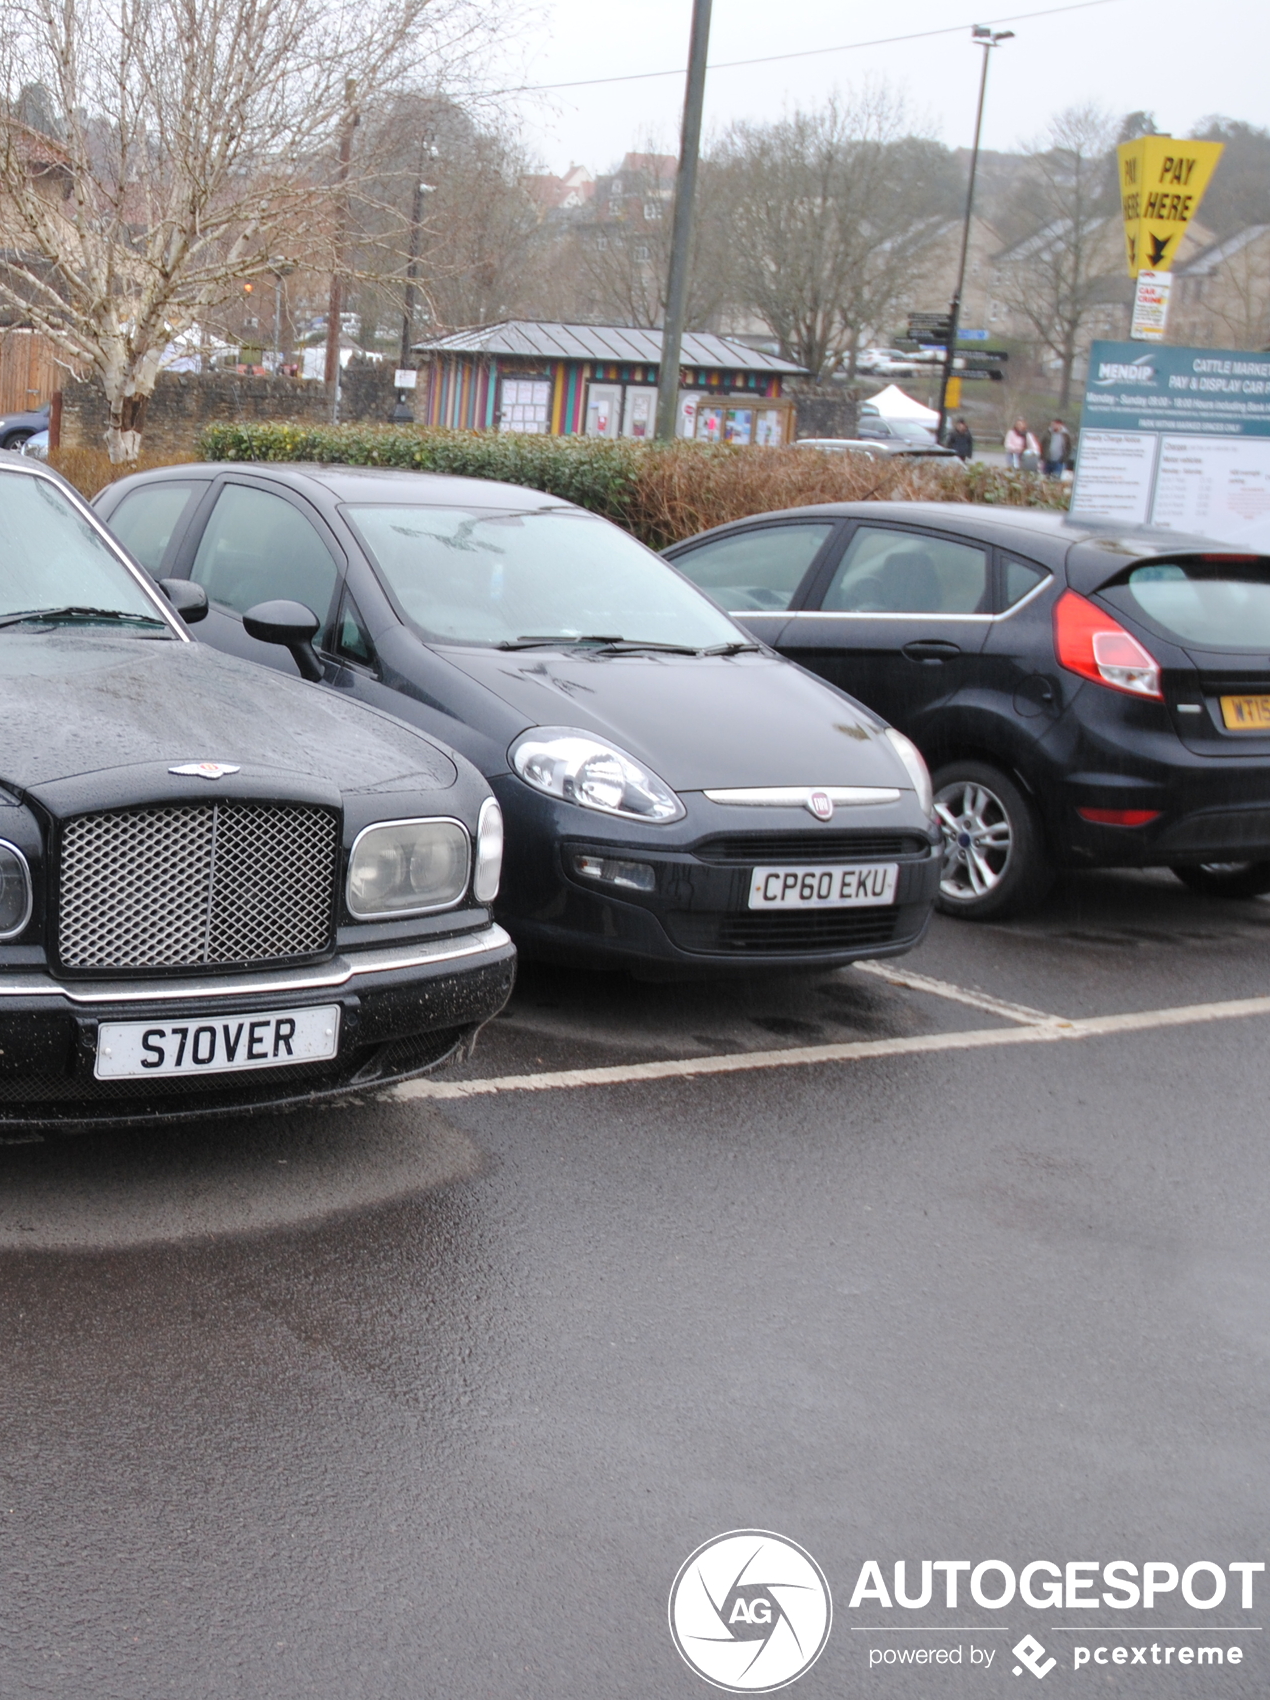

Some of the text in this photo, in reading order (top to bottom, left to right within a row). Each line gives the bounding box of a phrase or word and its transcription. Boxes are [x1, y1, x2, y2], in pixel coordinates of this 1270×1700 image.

[1158, 156, 1196, 186] PAY
[1143, 191, 1193, 222] HERE
[1138, 287, 1156, 295] CAR
[1099, 363, 1154, 379] MENDIP
[1192, 358, 1231, 375] CATTLE
[1168, 374, 1187, 390] PAY
[1189, 376, 1198, 391] &
[1199, 377, 1242, 393] DISPLAY
[1242, 379, 1264, 395] CAR
[1086, 391, 1116, 406] Monday
[1120, 393, 1148, 408] Sunday
[762, 868, 887, 902] CP60 EKU
